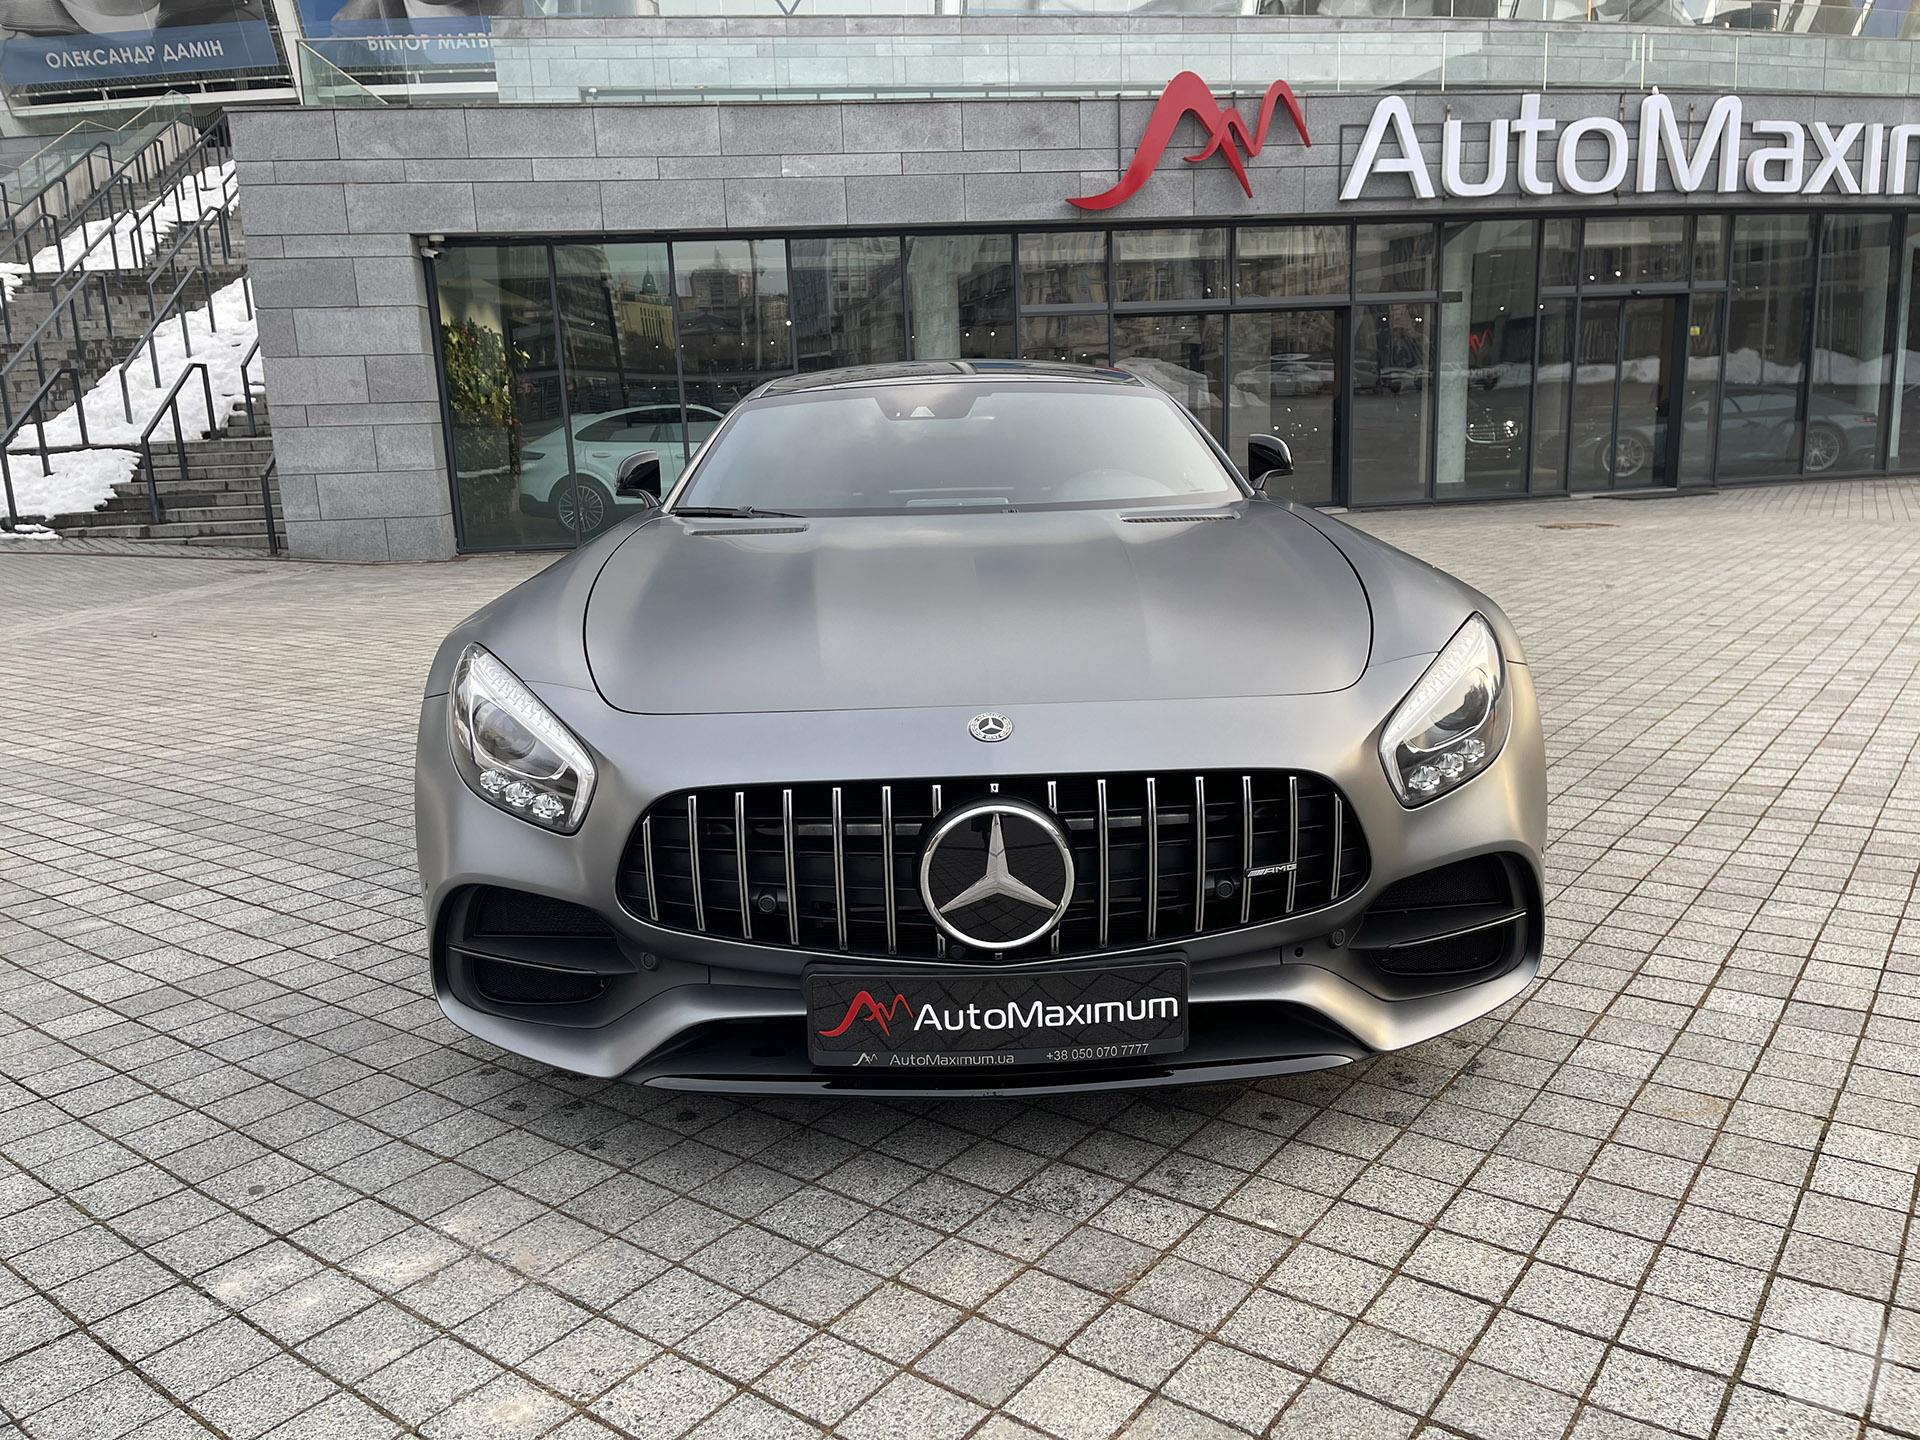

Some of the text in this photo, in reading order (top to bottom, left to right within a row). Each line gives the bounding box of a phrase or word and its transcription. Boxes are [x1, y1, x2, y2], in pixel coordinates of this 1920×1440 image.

[367, 34, 431, 51] ВІКТОР
[45, 39, 224, 69] ОЛЕКСАНДР ДАМІН
[1263, 863, 1297, 874] AMG
[913, 997, 1179, 1032] AutoMaximum
[889, 1054, 1015, 1066] AutoMaximum.ua
[1046, 1043, 1149, 1061] +38 050 070 7777
